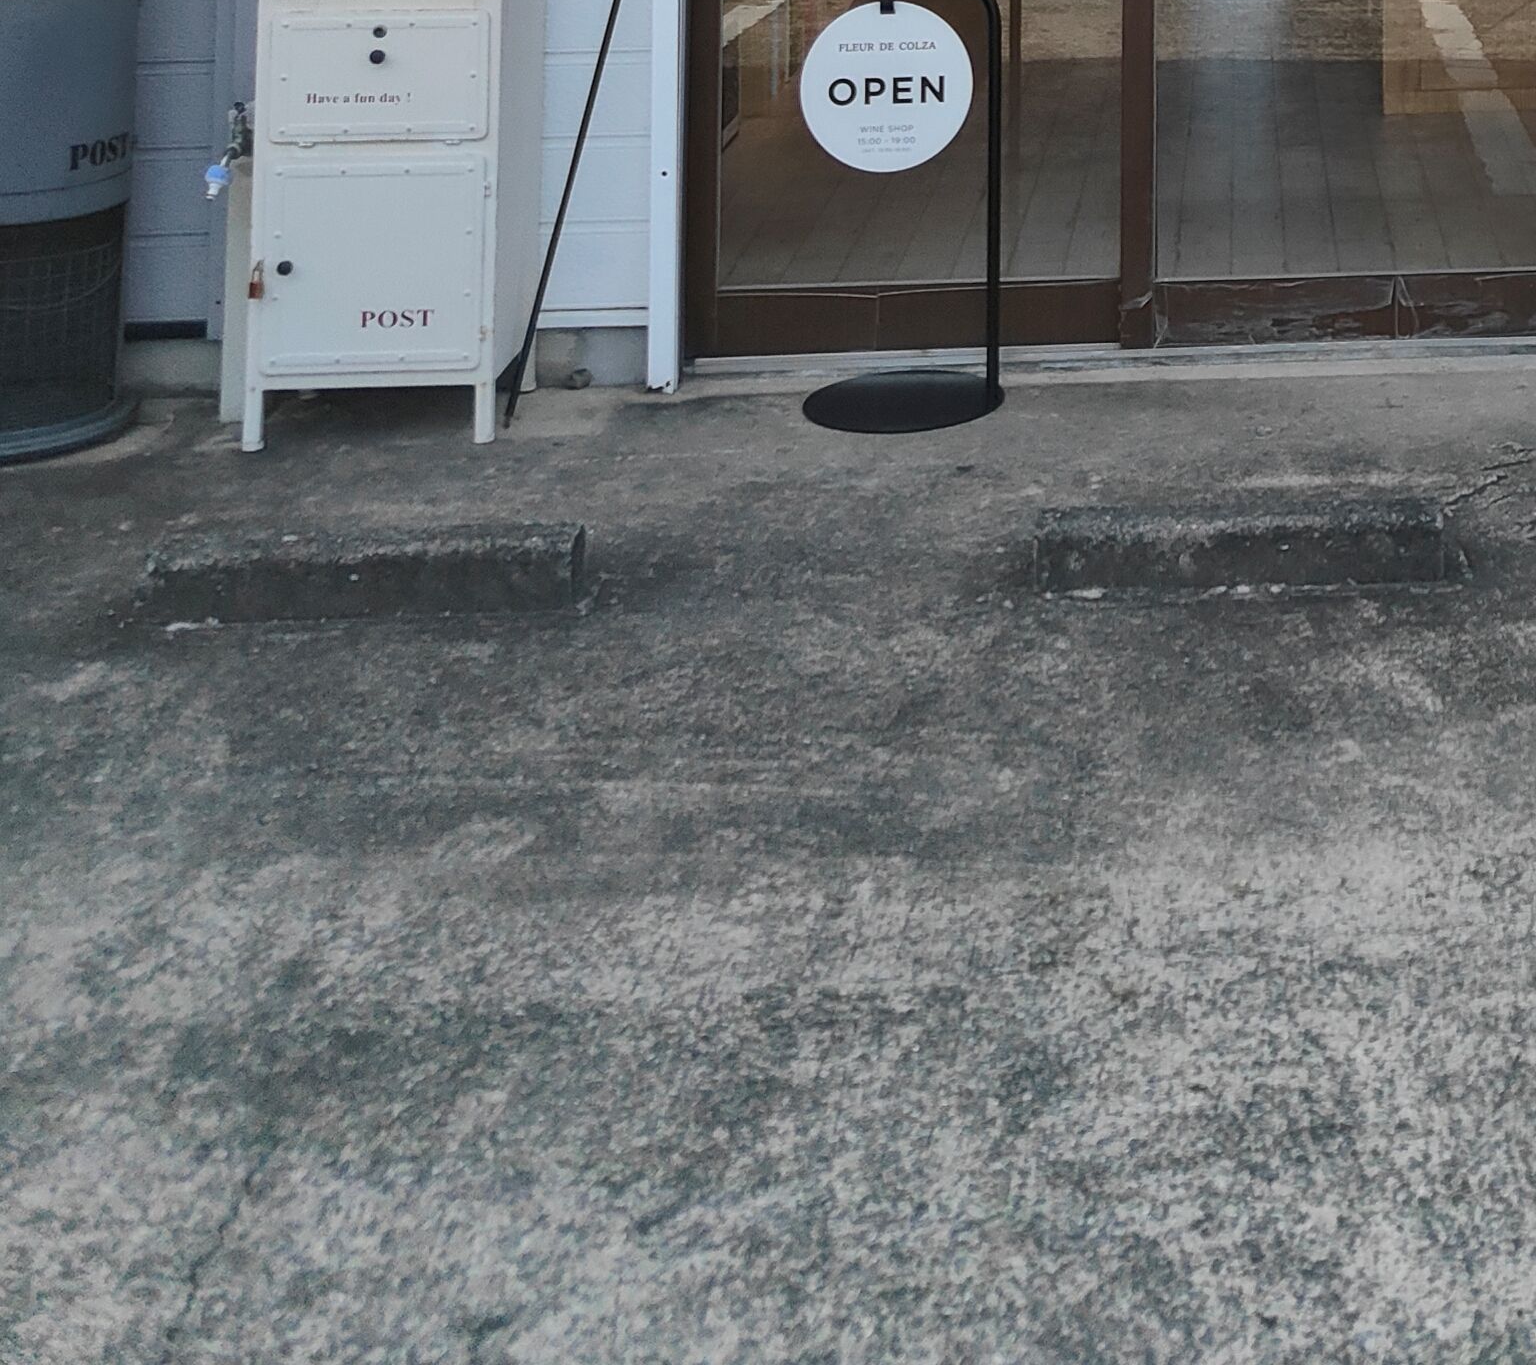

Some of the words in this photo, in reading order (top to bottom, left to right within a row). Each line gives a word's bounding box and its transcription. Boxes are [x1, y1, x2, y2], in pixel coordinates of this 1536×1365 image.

[839, 42, 875, 53] FLEUR
[880, 42, 894, 52] DE
[899, 41, 936, 51] COLZA
[306, 92, 339, 104] Have
[343, 95, 350, 103] a
[354, 92, 376, 103] fun
[380, 92, 401, 106] day
[828, 76, 946, 107] OPEN
[859, 125, 885, 133] WINE
[887, 124, 914, 133] SHOP
[69, 132, 131, 171] POST
[360, 309, 435, 328] POST
